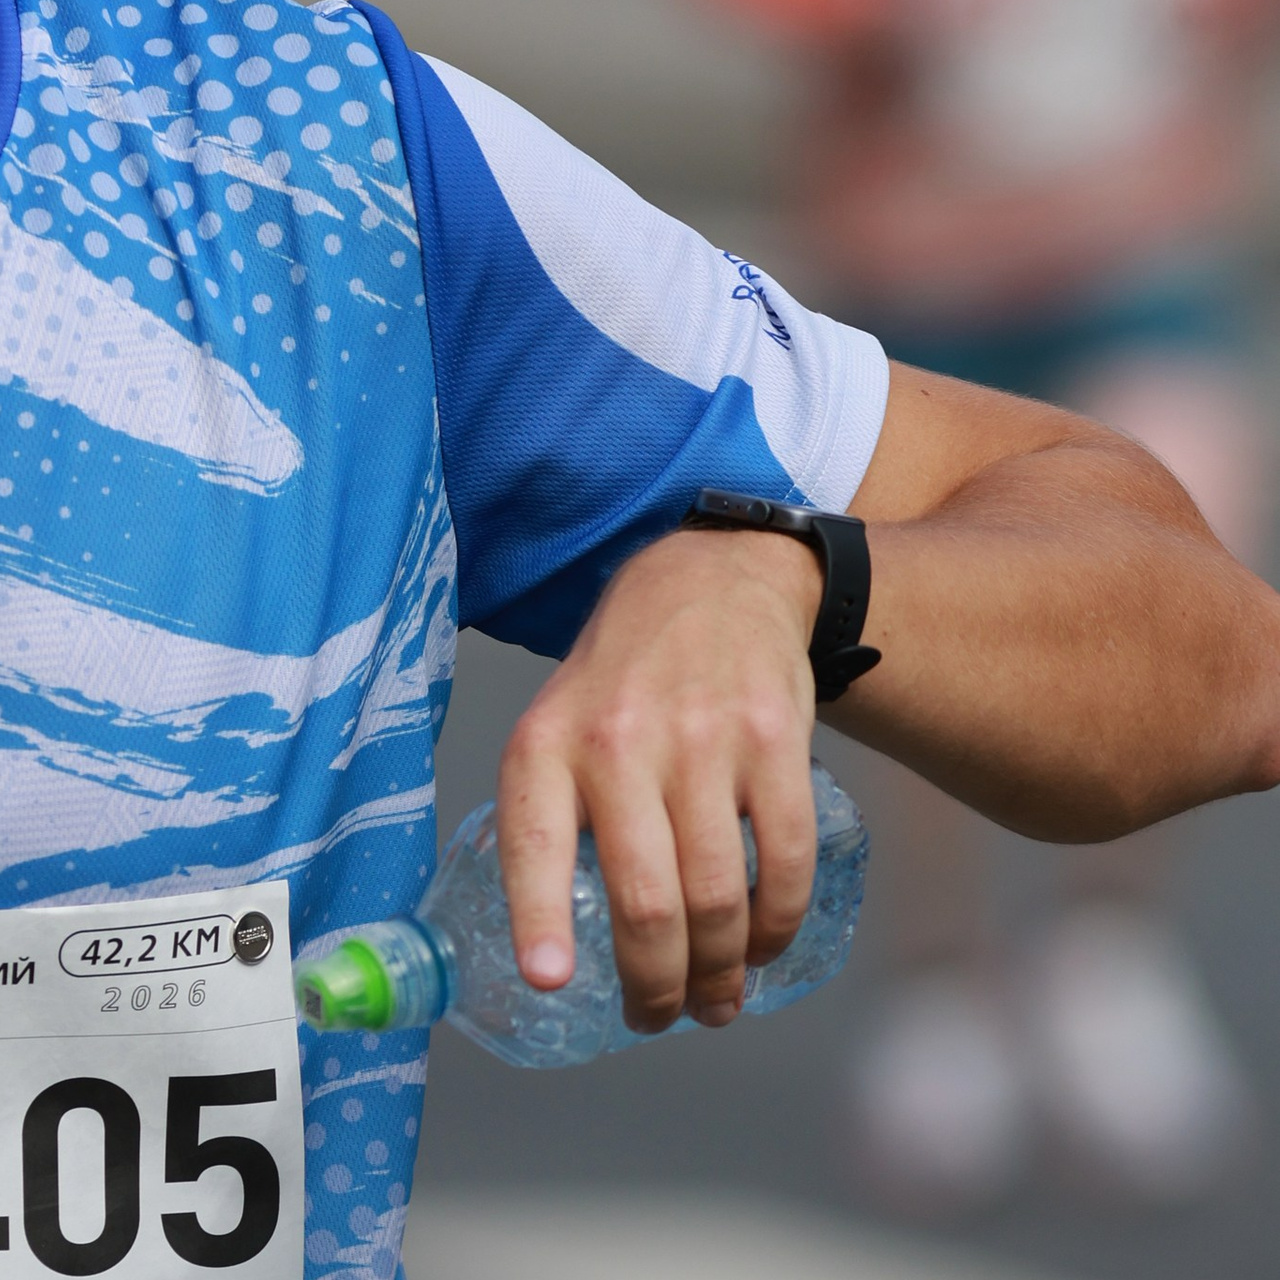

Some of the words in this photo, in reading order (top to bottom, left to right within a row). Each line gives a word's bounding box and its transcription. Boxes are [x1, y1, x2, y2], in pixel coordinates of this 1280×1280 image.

[80, 934, 157, 968] 42,2
[171, 925, 220, 959] КМ
[100, 979, 206, 1012] 2026
